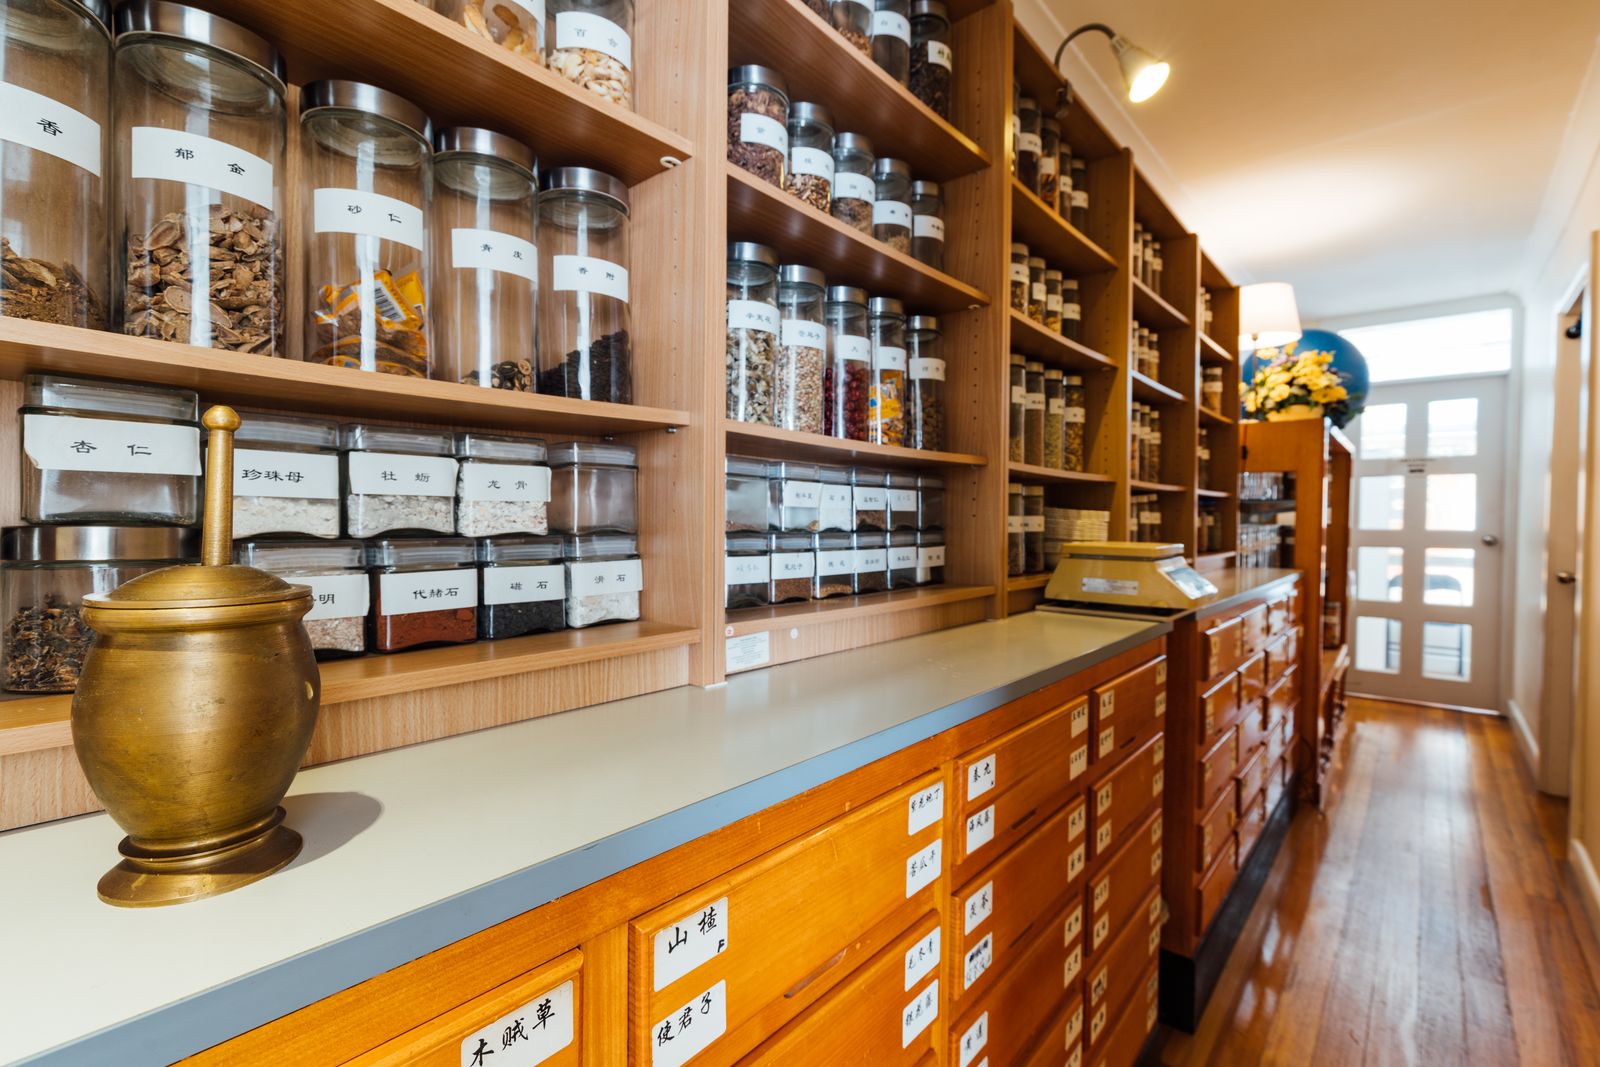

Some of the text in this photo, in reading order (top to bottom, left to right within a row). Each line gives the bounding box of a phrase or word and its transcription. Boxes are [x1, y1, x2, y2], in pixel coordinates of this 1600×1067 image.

[36, 117, 63, 136] 香
[175, 147, 246, 176] 郁金
[347, 204, 403, 224] 砂仁
[69, 439, 153, 457] 杏仁
[241, 468, 304, 484] 珍珠母
[381, 470, 431, 483] 牡蛎
[487, 479, 528, 491] 龙骨
[412, 587, 460, 600] 代赭石
[509, 580, 550, 592] 磁石
[315, 593, 336, 605] 明
[667, 905, 719, 955] 山楂
[656, 991, 713, 1048] 使君子
[469, 997, 556, 1067] 木贼草
